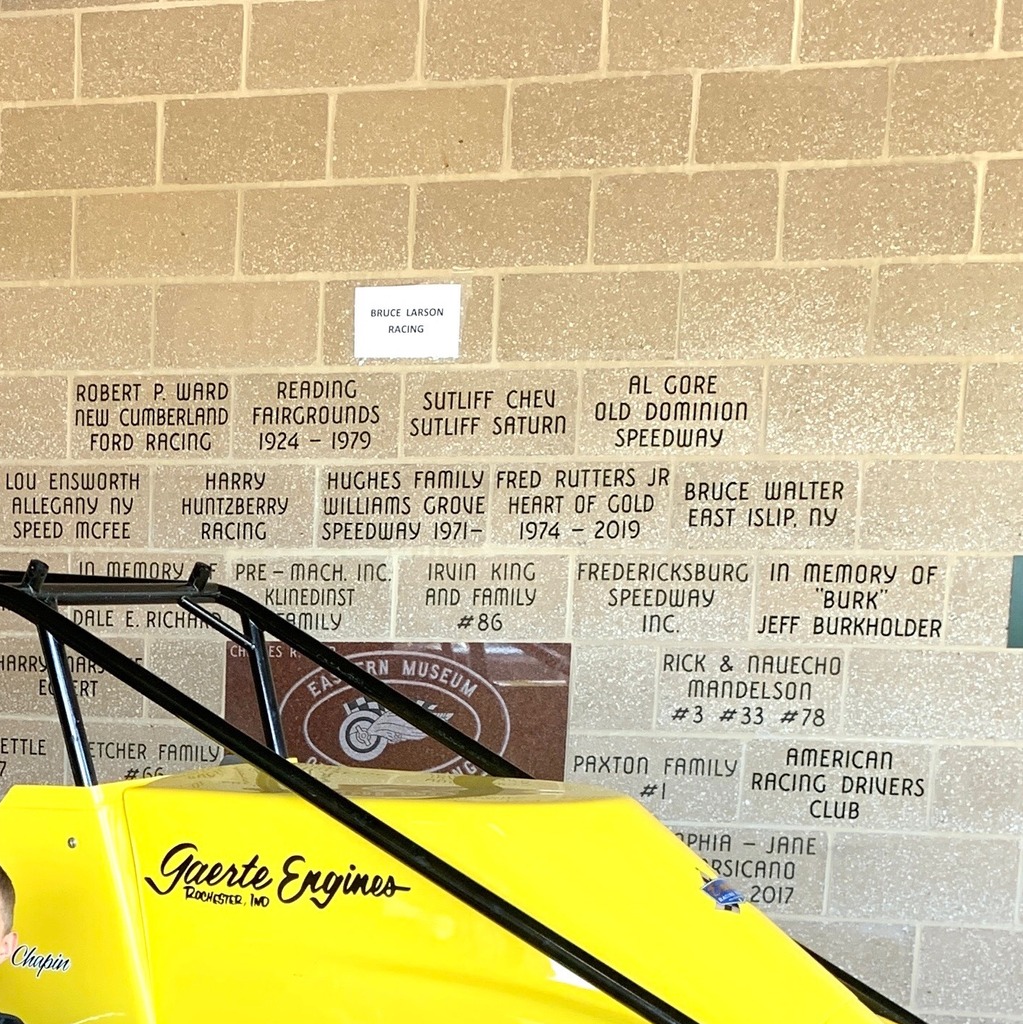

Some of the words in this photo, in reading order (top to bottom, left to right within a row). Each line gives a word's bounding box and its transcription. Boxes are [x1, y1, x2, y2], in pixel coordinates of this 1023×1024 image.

[370, 308, 401, 318] BRUCE
[406, 307, 444, 317] LARSON
[388, 324, 424, 334] RACING
[76, 383, 142, 403] ROBERT
[153, 383, 166, 401] P.
[176, 382, 229, 402] WARD
[277, 379, 357, 400] READING
[628, 375, 653, 395] AL
[664, 374, 718, 395] GORE
[422, 390, 494, 411] SUTLIFF
[506, 389, 556, 410] CHEV
[75, 408, 109, 427] NEW
[119, 407, 229, 427] CUMBERLAND
[252, 405, 380, 426] FAIRGROUNDS
[594, 401, 631, 421] OLD
[645, 401, 748, 422] DOMINION
[409, 417, 481, 437] SUTLIFF
[492, 415, 566, 436] SATURN
[90, 432, 134, 452] FORD
[146, 432, 212, 451] RACING
[259, 431, 299, 451] 1924
[331, 430, 371, 450] 1979
[614, 428, 724, 448] SPEEDWAY
[6, 472, 37, 491] LOU
[49, 472, 140, 491] ENSWORTH
[205, 471, 266, 491] HARRY
[327, 470, 401, 490] HUGHES
[414, 470, 484, 489] FAMILY
[496, 470, 542, 489] FRED
[555, 467, 636, 488] RUTTERS
[647, 467, 670, 487] JR
[684, 481, 750, 502] BRUCE
[764, 480, 844, 501] WALTER
[12, 496, 99, 515] ALLEGANY
[110, 496, 134, 515] NY
[181, 497, 289, 516] HUNTZBERRY
[323, 496, 411, 516] WILLIAMS
[423, 495, 486, 515] GROVE
[508, 495, 565, 515] HEART
[574, 494, 597, 514] OF
[607, 493, 654, 514] GOLD
[688, 508, 736, 528] EAST
[748, 507, 797, 528] ISLIP,
[809, 507, 838, 527] NY
[13, 520, 63, 539] SPEED
[75, 521, 131, 540] MCFEE
[201, 521, 267, 541] RACING
[321, 521, 421, 541] SPEEDWAY
[519, 521, 561, 540] 1974
[594, 519, 641, 540] 2019
[79, 561, 95, 577] IN
[107, 562, 184, 579] MEMORY
[235, 563, 267, 581] PRE
[290, 563, 347, 582] MACH.
[357, 564, 392, 581] INC.
[428, 562, 476, 581] IRVIN
[491, 562, 536, 582] KING
[577, 562, 749, 583] FREDERICKSBURG
[770, 562, 790, 582] IN
[803, 562, 898, 584] MEMORY
[911, 565, 938, 585] OF
[265, 588, 356, 607] KLINEDINST
[425, 587, 461, 606] AND
[472, 587, 537, 607] FAMILY
[607, 587, 715, 608] SPEEDWAY
[74, 610, 114, 627] DALE
[125, 610, 140, 628] E.
[457, 612, 503, 632] #86
[642, 614, 680, 634] INC.
[757, 615, 801, 635] JEFF
[813, 616, 942, 638] BURKHOLDER
[230, 645, 282, 658] CHES
[663, 653, 706, 673] RICK
[719, 654, 734, 673] &
[306, 659, 389, 698] EARN
[402, 659, 478, 699] MUSEUM
[687, 679, 812, 701] MANDELSON
[671, 705, 704, 724] #3
[719, 706, 764, 725] #33
[780, 708, 825, 727] #78
[88, 741, 147, 760] ETCHER
[159, 744, 220, 762] FAMILY
[786, 747, 893, 770] AMERICAN
[573, 755, 649, 775] PAXTON
[664, 757, 738, 778] FAMILY
[751, 772, 827, 794] RACING
[841, 775, 925, 797] DRIVERS
[809, 799, 860, 820] CLUB
[678, 833, 732, 852] PHIA
[765, 836, 817, 856] JANE
[144, 842, 273, 895] Gaerte
[277, 854, 411, 909] Engines
[750, 885, 794, 905] 2017
[10, 945, 72, 978] Chapin
